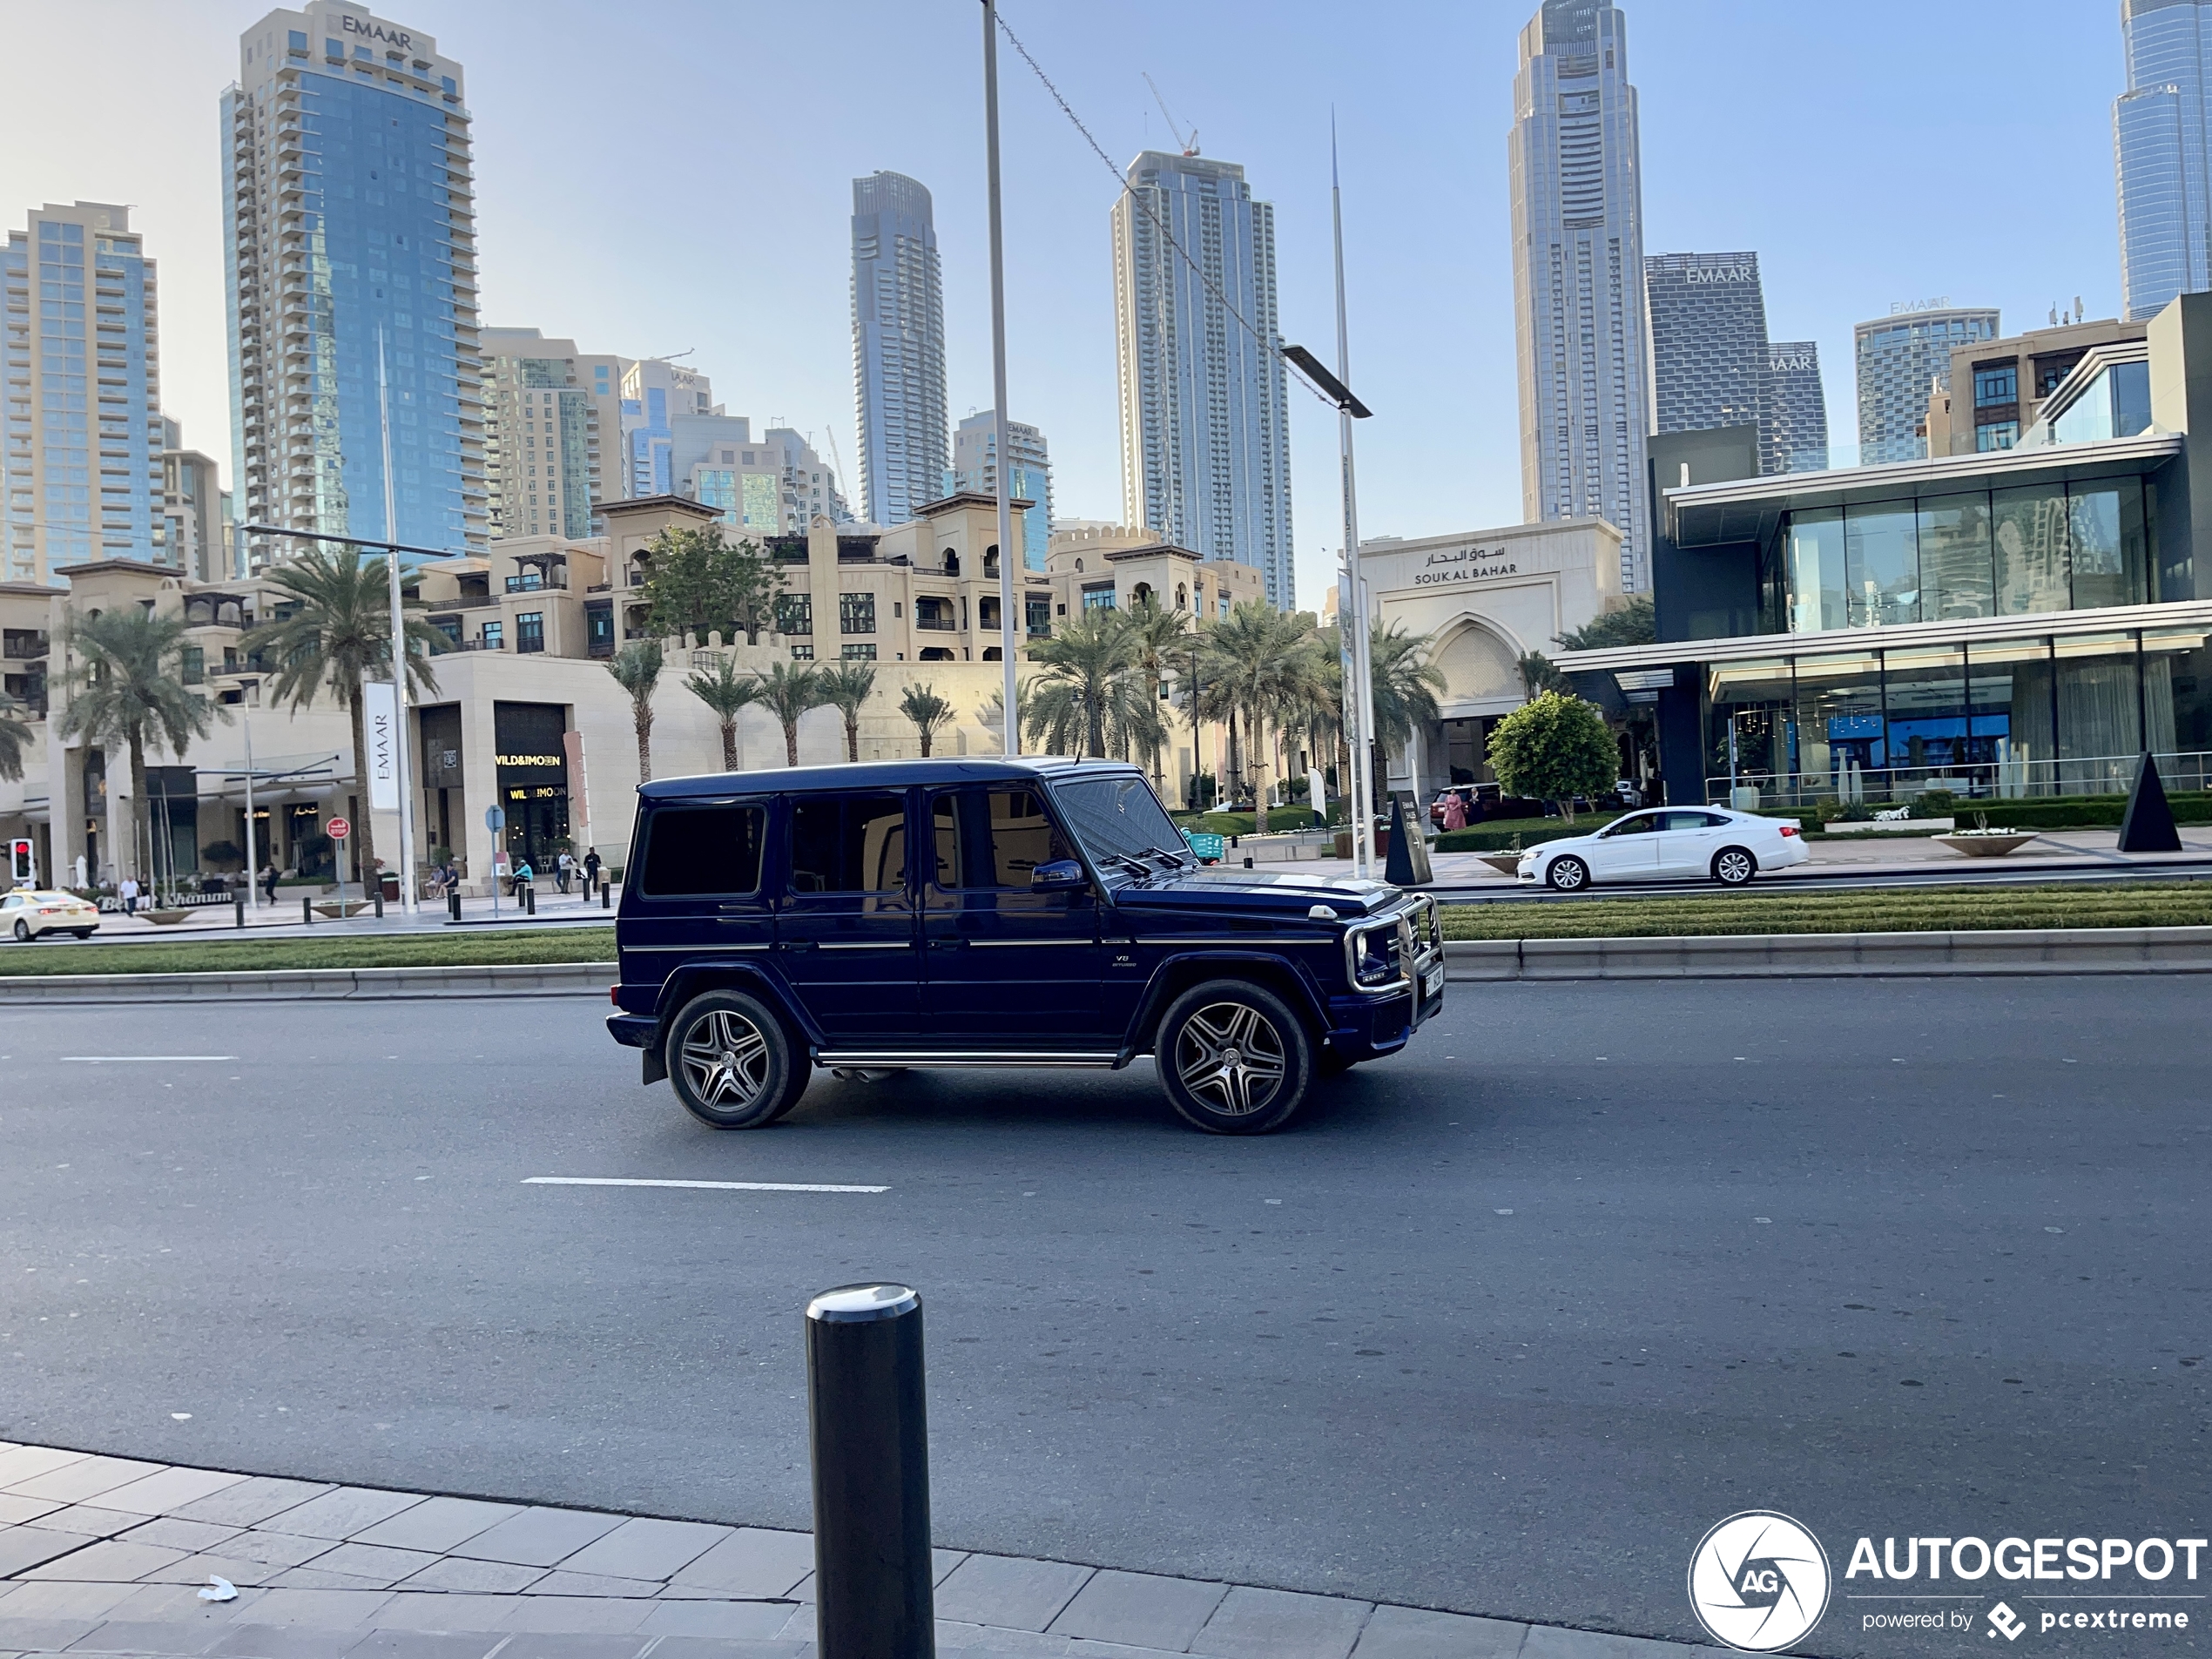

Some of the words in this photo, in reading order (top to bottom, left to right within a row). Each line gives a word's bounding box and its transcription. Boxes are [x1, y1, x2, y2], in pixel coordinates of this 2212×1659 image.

[342, 15, 413, 51] EMAAR
[1686, 266, 1752, 284] EMAAR
[1890, 296, 1952, 314] EMAAR
[1426, 550, 1467, 567] البحار
[1468, 547, 1505, 562] سوق
[1415, 571, 1451, 584] SOUK
[1453, 570, 1469, 581] AL
[1473, 564, 1517, 577] BAHAR
[374, 714, 390, 779] EMAAR
